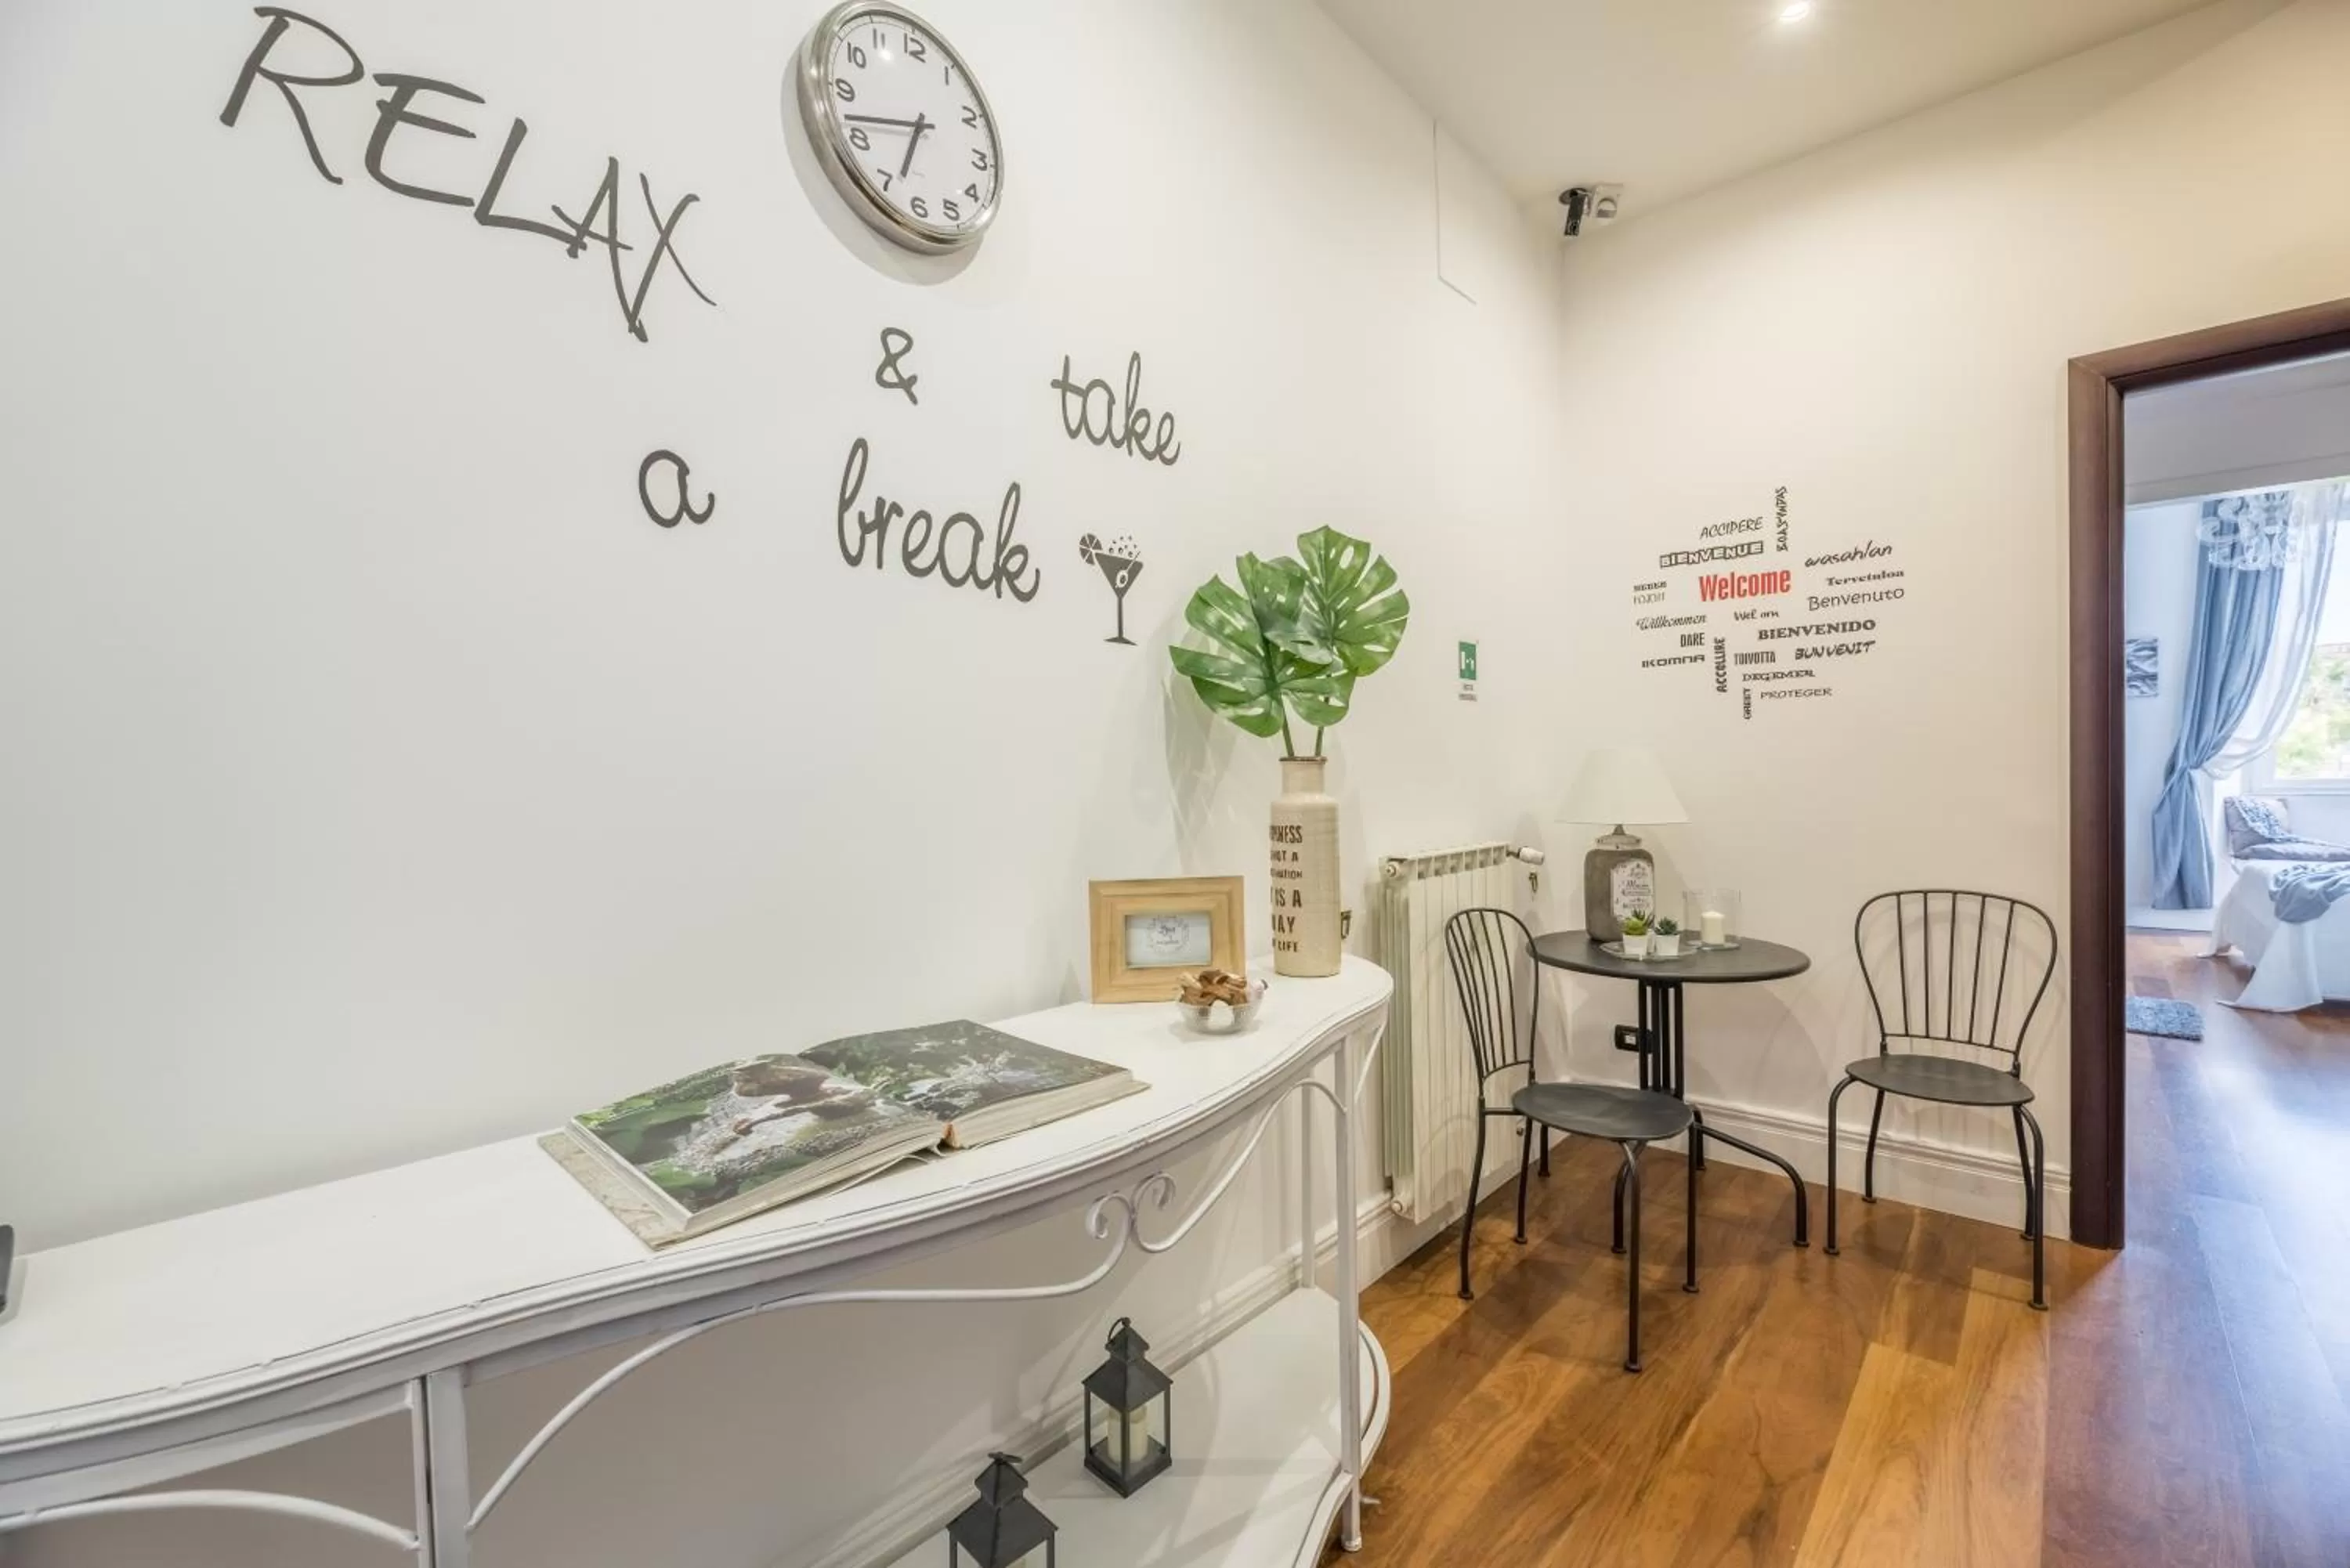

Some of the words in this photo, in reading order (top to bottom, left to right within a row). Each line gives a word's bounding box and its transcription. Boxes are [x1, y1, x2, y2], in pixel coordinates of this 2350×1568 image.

[873, 28, 885, 49] 11
[904, 31, 928, 63] 12
[848, 42, 866, 69] 10
[945, 66, 949, 85] 1
[835, 78, 855, 102] 9
[962, 105, 978, 129] 2
[848, 127, 870, 152] 8
[971, 149, 987, 171] 3
[219, 6, 717, 343] RELAX
[876, 169, 892, 193] 7
[964, 183, 979, 203] 4
[909, 197, 928, 219] 6
[943, 199, 960, 221] 5
[876, 327, 918, 406] &
[1050, 351, 1180, 466] take
[638, 450, 715, 529] a
[837, 438, 1040, 603] break
[1700, 517, 1763, 539] ACCIPERE
[1660, 540, 1764, 569] BIENVENUE
[1698, 570, 1791, 602] Welcome
[1807, 589, 1904, 611] Benvenuto
[1636, 615, 1706, 630] Willkommen
[1759, 620, 1876, 641] BIENVENIDO
[1680, 633, 1705, 648] DARE
[1734, 652, 1776, 665] TOIVOTTA
[1761, 688, 1832, 699] PROTEGER
[1292, 889, 1302, 908] A
[1278, 941, 1298, 952] LIFE
